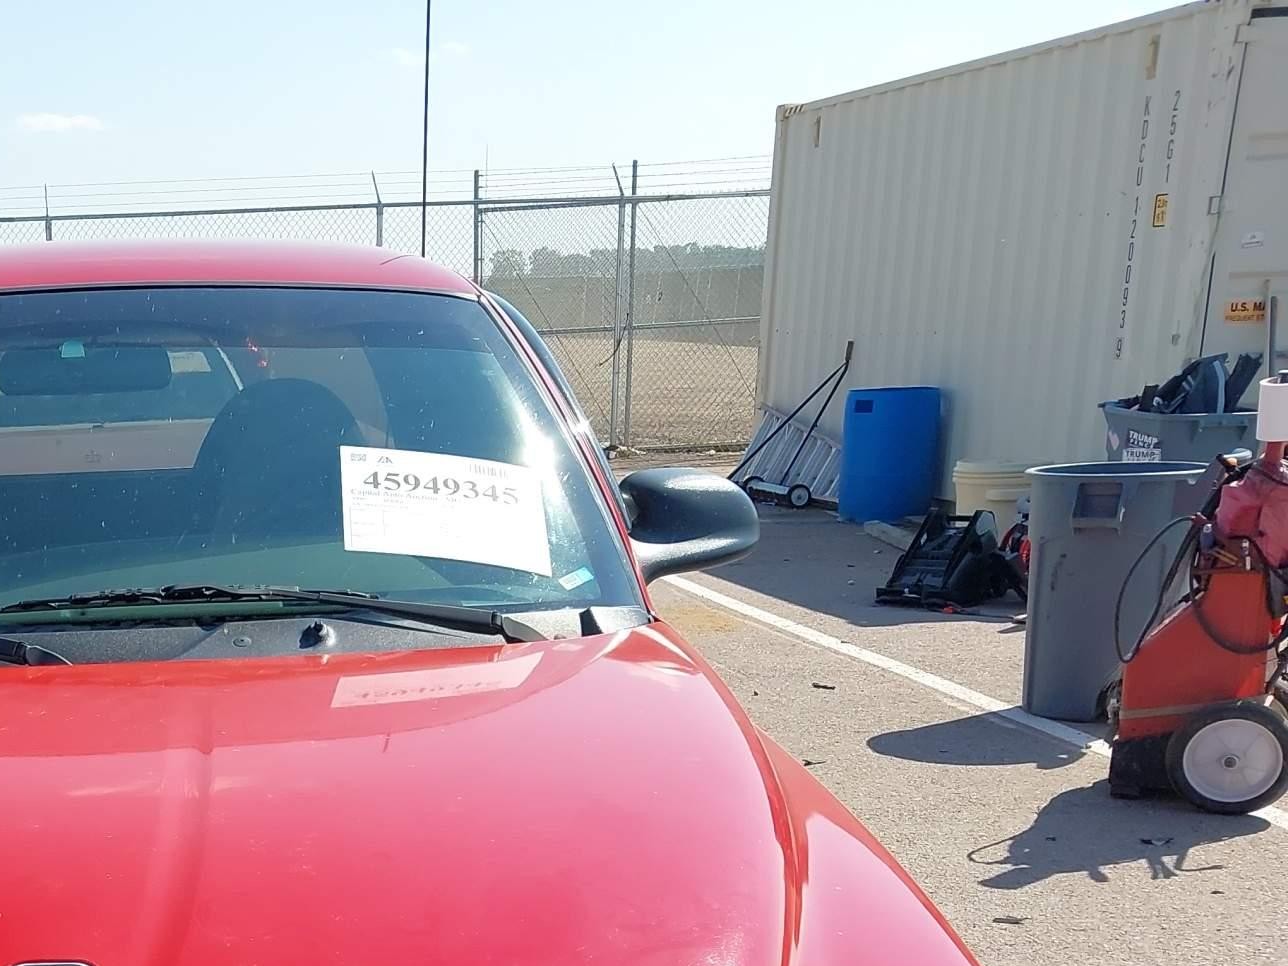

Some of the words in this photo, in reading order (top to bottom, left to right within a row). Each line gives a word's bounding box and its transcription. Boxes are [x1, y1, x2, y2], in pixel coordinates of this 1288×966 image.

[1165, 89, 1182, 183] 25G1
[1230, 302, 1250, 312] U.S.
[1129, 430, 1159, 444] TRUMP
[1127, 450, 1157, 458] TRUMP
[363, 470, 519, 505] 45949345
